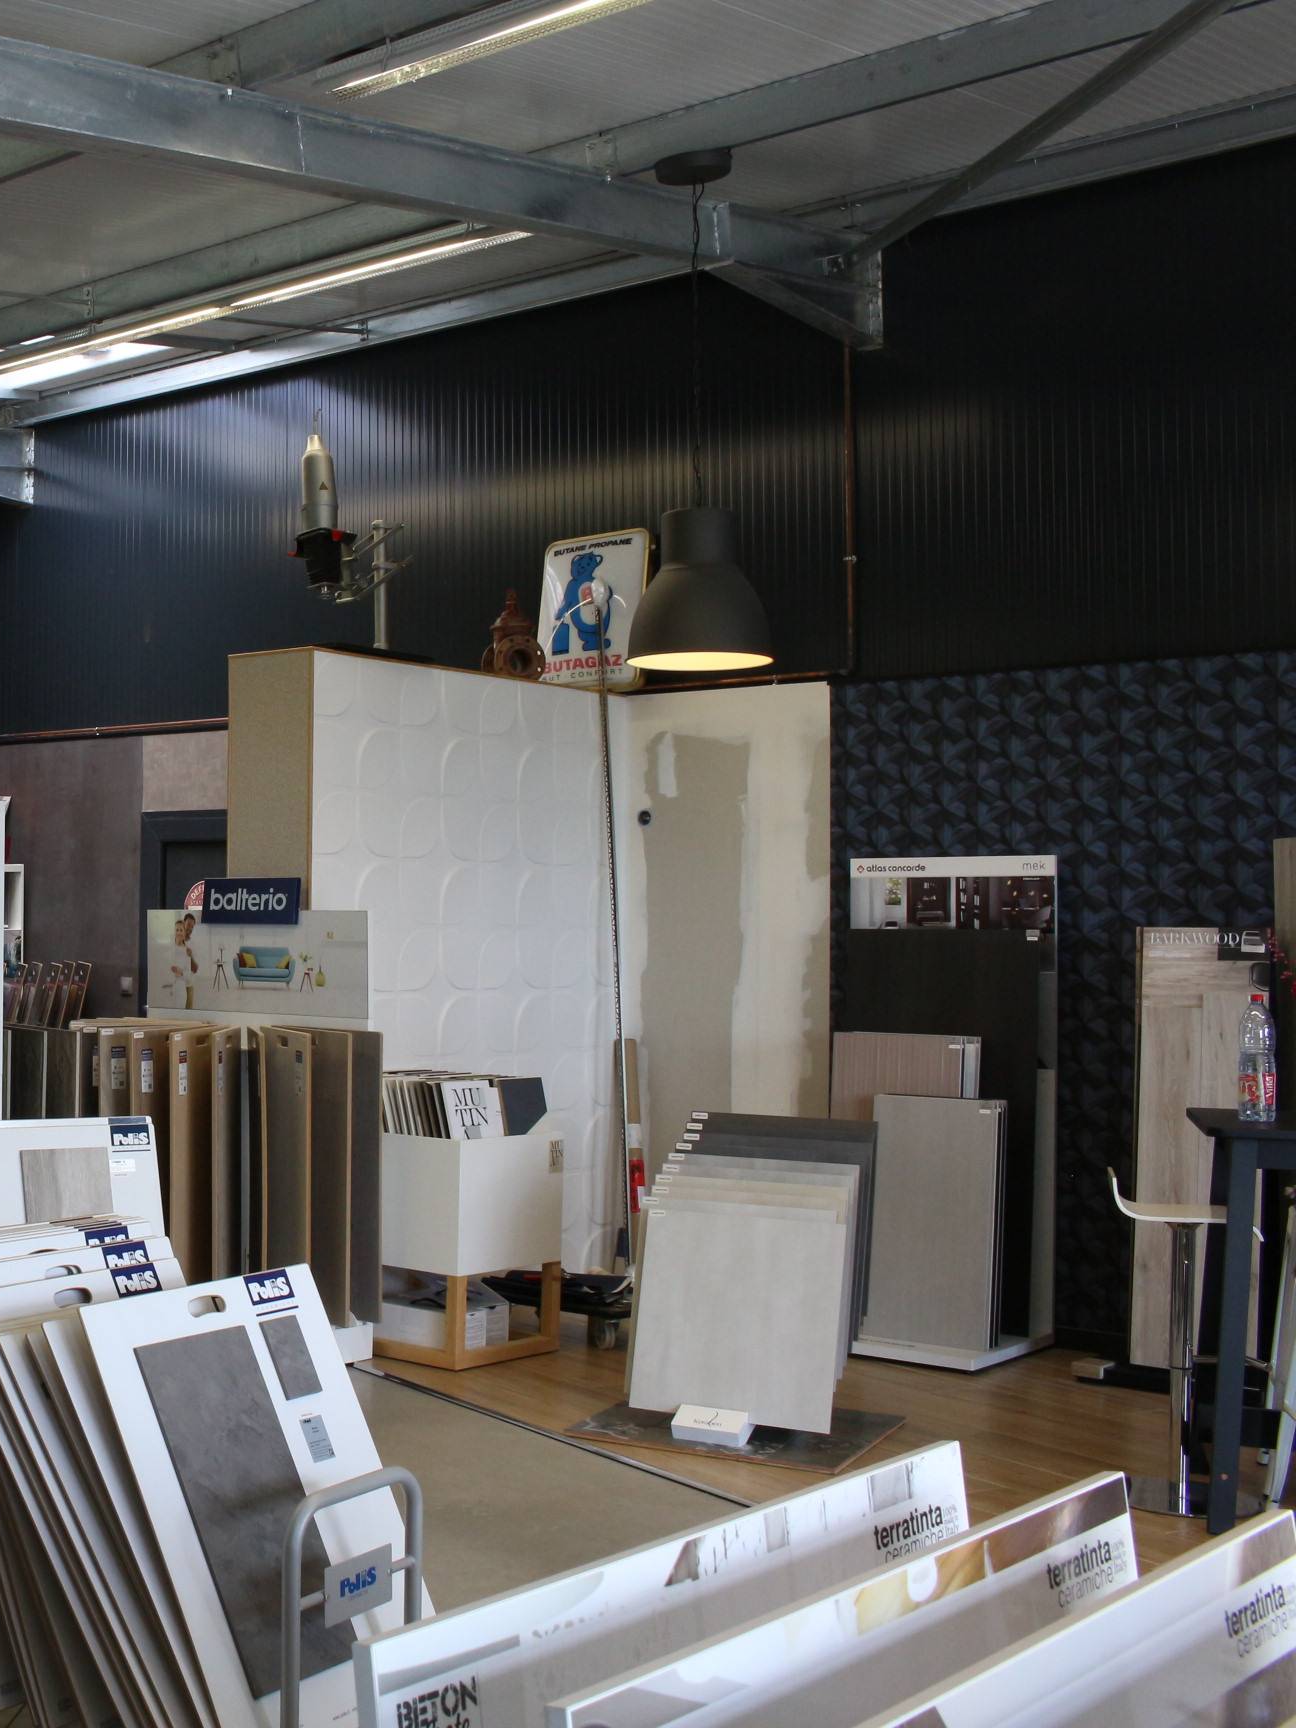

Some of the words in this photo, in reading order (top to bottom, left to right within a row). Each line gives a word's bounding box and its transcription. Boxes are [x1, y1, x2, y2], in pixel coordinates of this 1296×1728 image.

[554, 544, 586, 557] BUTANE
[588, 537, 633, 550] PROPANE
[866, 864, 887, 873] atlas
[888, 863, 926, 873] concorde
[209, 888, 287, 911] balterio
[1150, 931, 1240, 945] BARKWOOD
[452, 1087, 480, 1107] MU
[874, 1504, 943, 1550] terratinta
[1046, 1539, 1112, 1590] terratinta
[1057, 1564, 1113, 1608] ceramiche
[1224, 1583, 1286, 1639] terratinta
[396, 1675, 479, 1728] BETON
